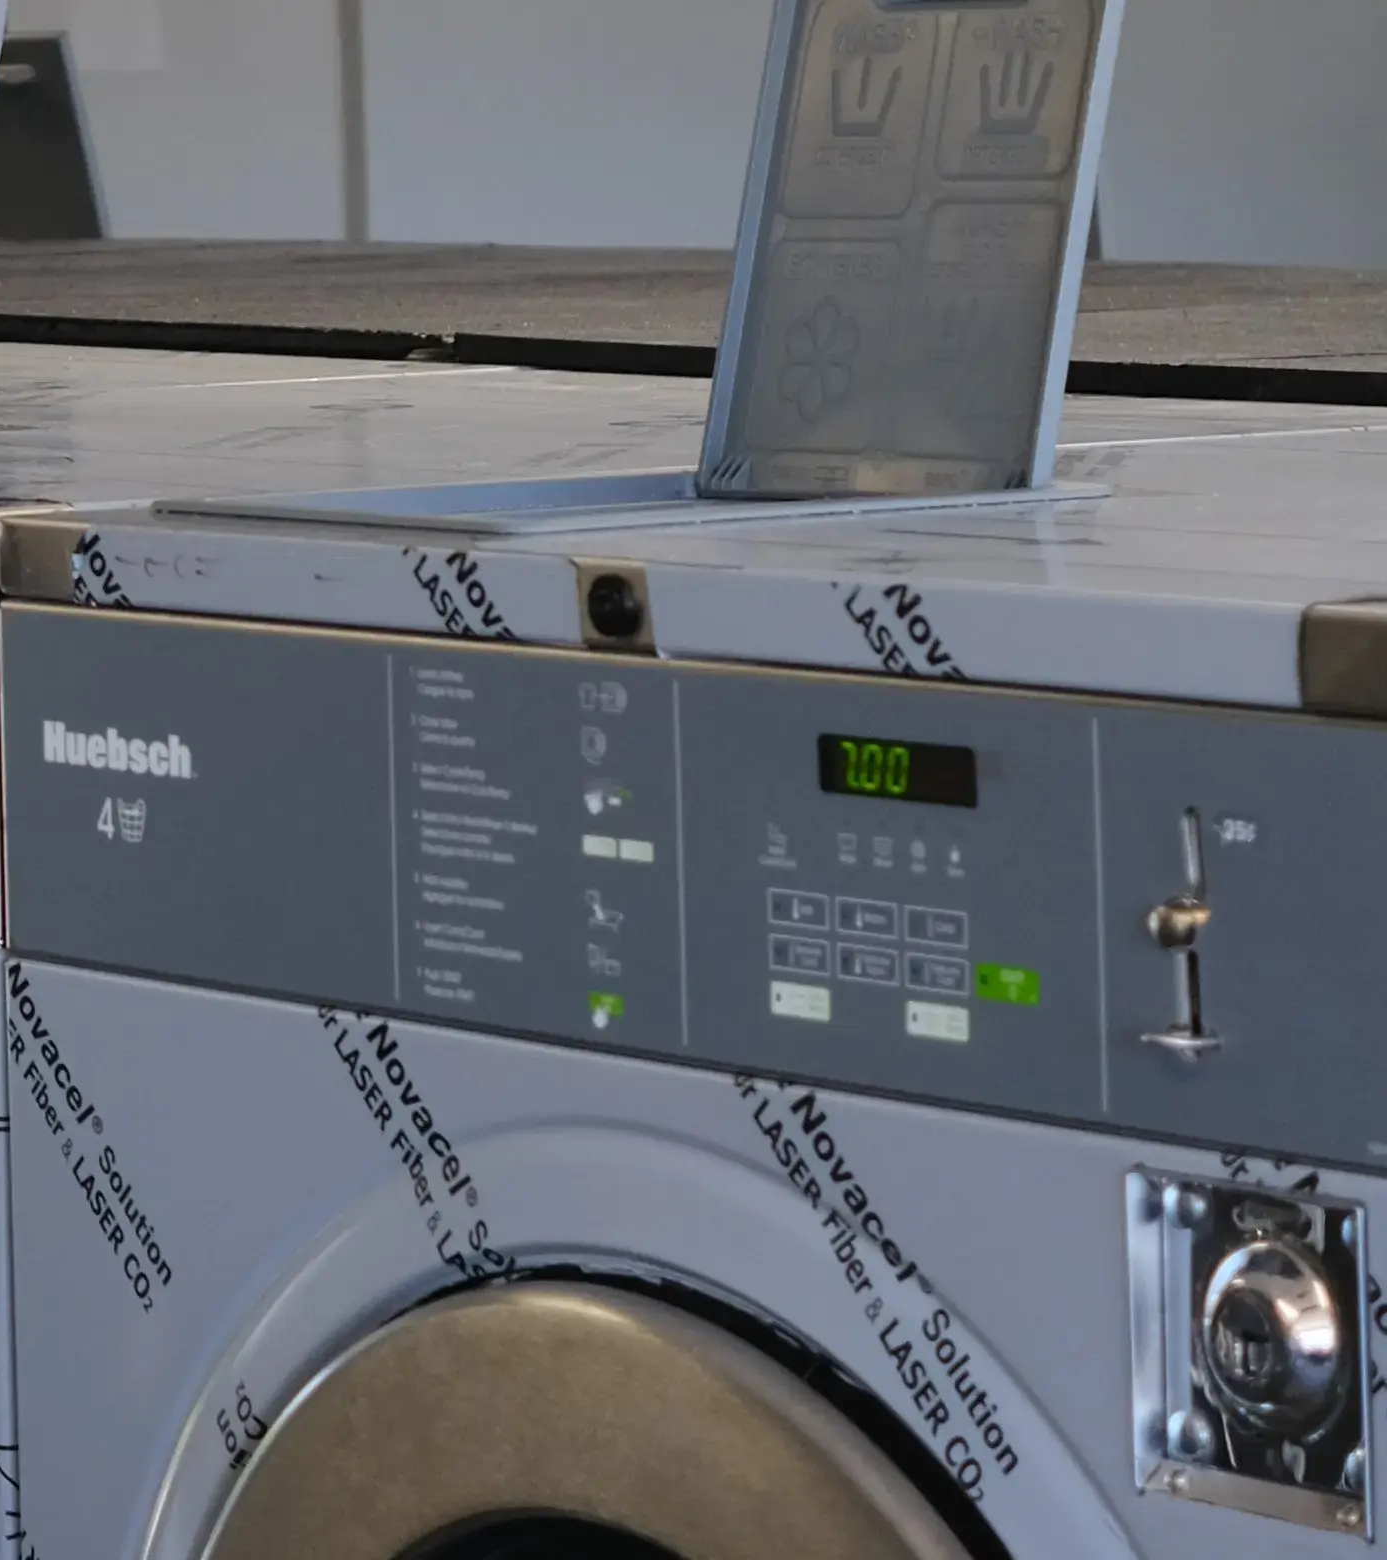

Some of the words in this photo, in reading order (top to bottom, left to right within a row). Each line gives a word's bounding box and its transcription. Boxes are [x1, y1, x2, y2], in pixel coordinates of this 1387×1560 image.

[43, 721, 192, 779] Huebsch
[97, 797, 115, 840] 4
[23, 1061, 64, 1136] Fiber
[61, 1138, 73, 1163] &
[72, 1155, 124, 1256] LASER
[333, 1028, 392, 1132] LASER
[390, 1128, 434, 1207] Fiber
[98, 1145, 172, 1286] Solution
[753, 1097, 822, 1211] LASER
[820, 1207, 874, 1294] Fiber
[865, 1297, 885, 1323] &
[879, 1318, 951, 1438] LASER
[921, 1308, 1019, 1476] Solution
